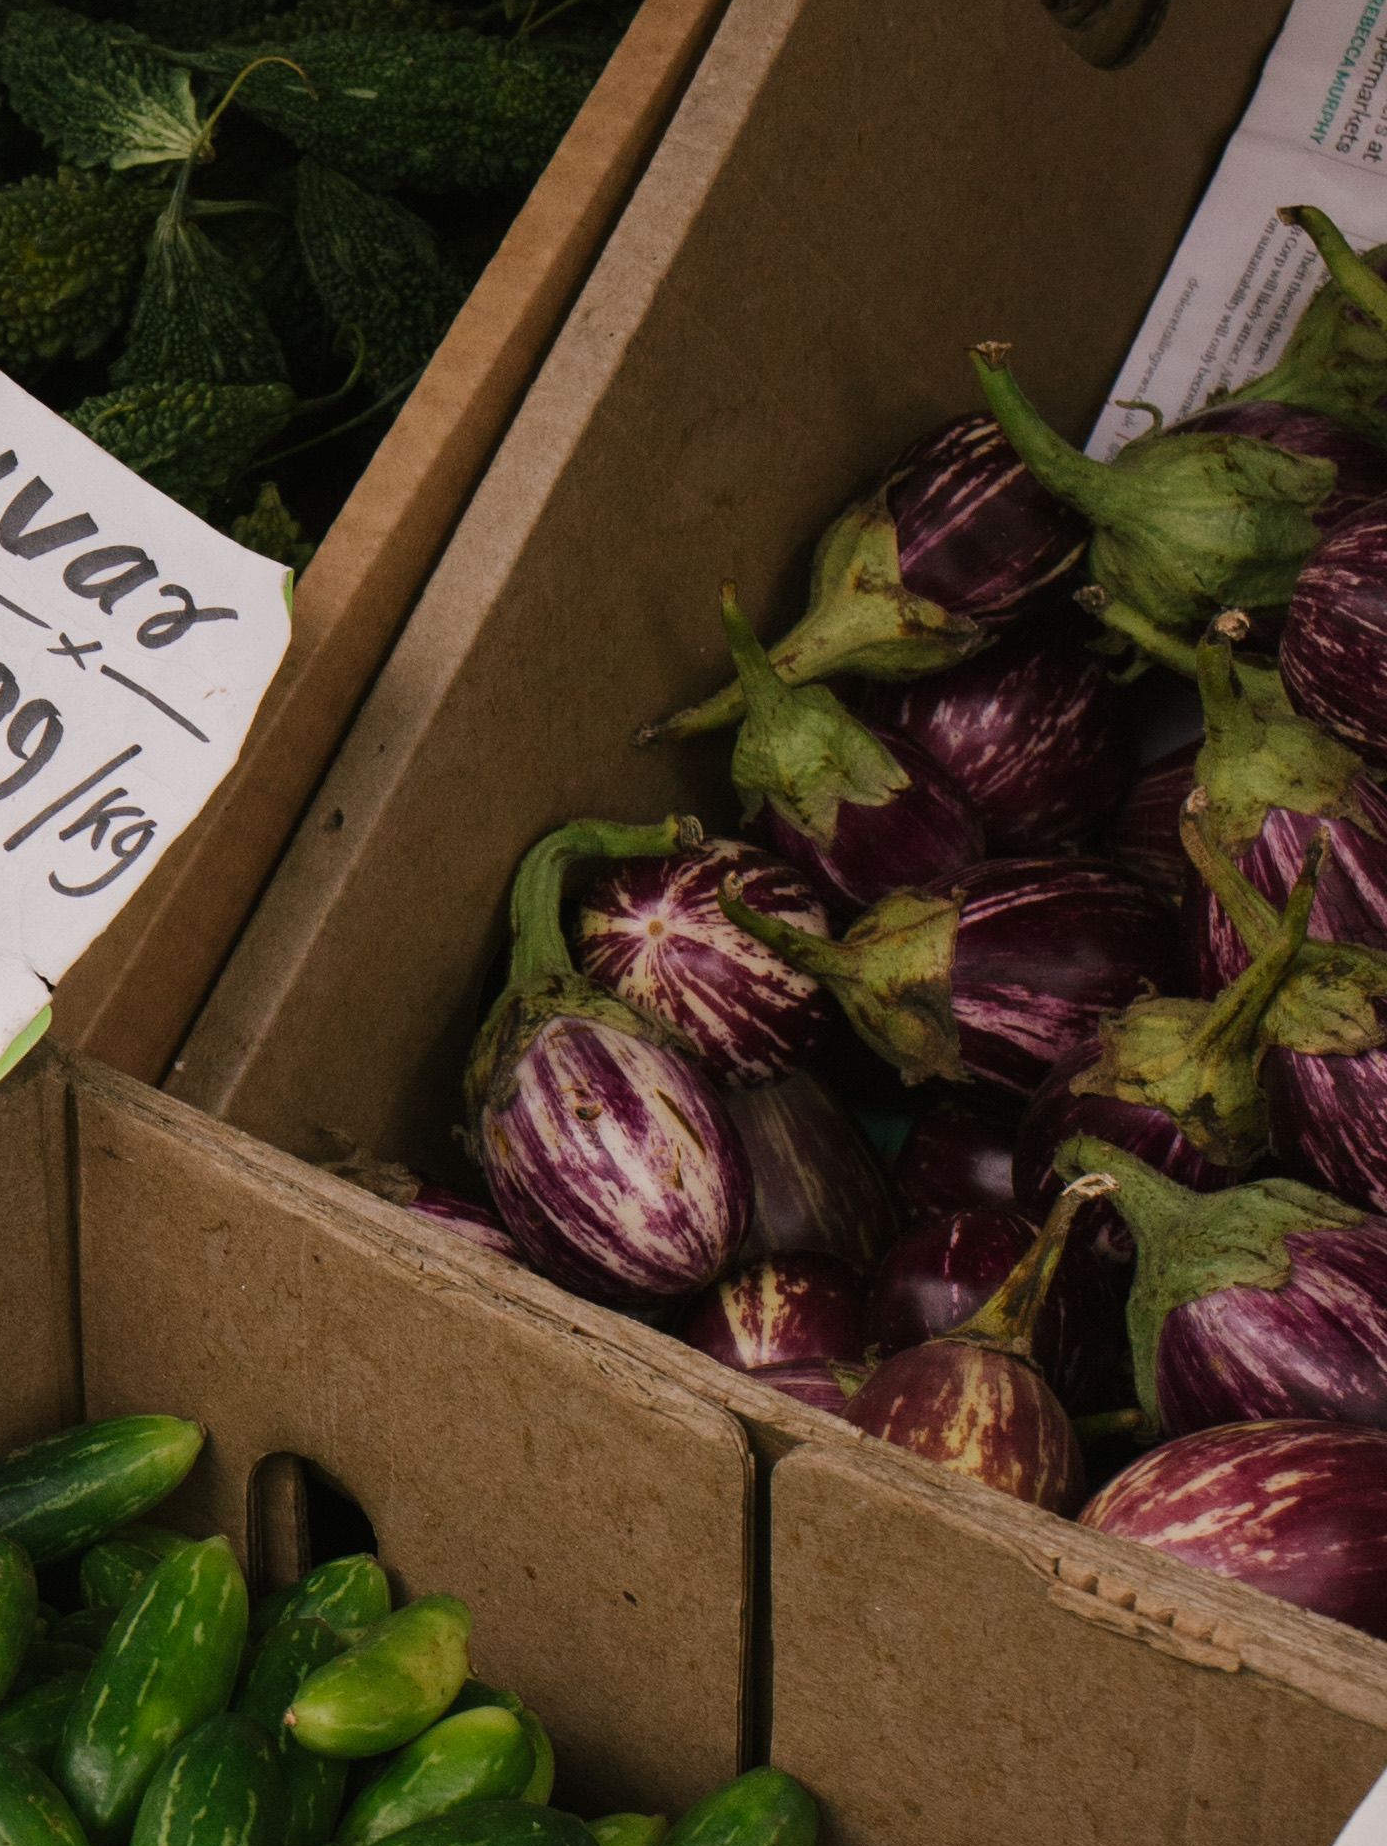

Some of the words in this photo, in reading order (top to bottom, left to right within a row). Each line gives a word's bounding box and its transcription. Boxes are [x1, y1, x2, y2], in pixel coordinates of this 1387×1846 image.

[1310, 69, 1351, 146] MURPHY
[1265, 216, 1280, 235] on
[1274, 236, 1298, 269] Corp
[1224, 235, 1271, 315] sustainability
[1263, 269, 1281, 292] will
[1246, 291, 1273, 324] likely
[1214, 314, 1232, 338] will
[1200, 337, 1220, 364] only
